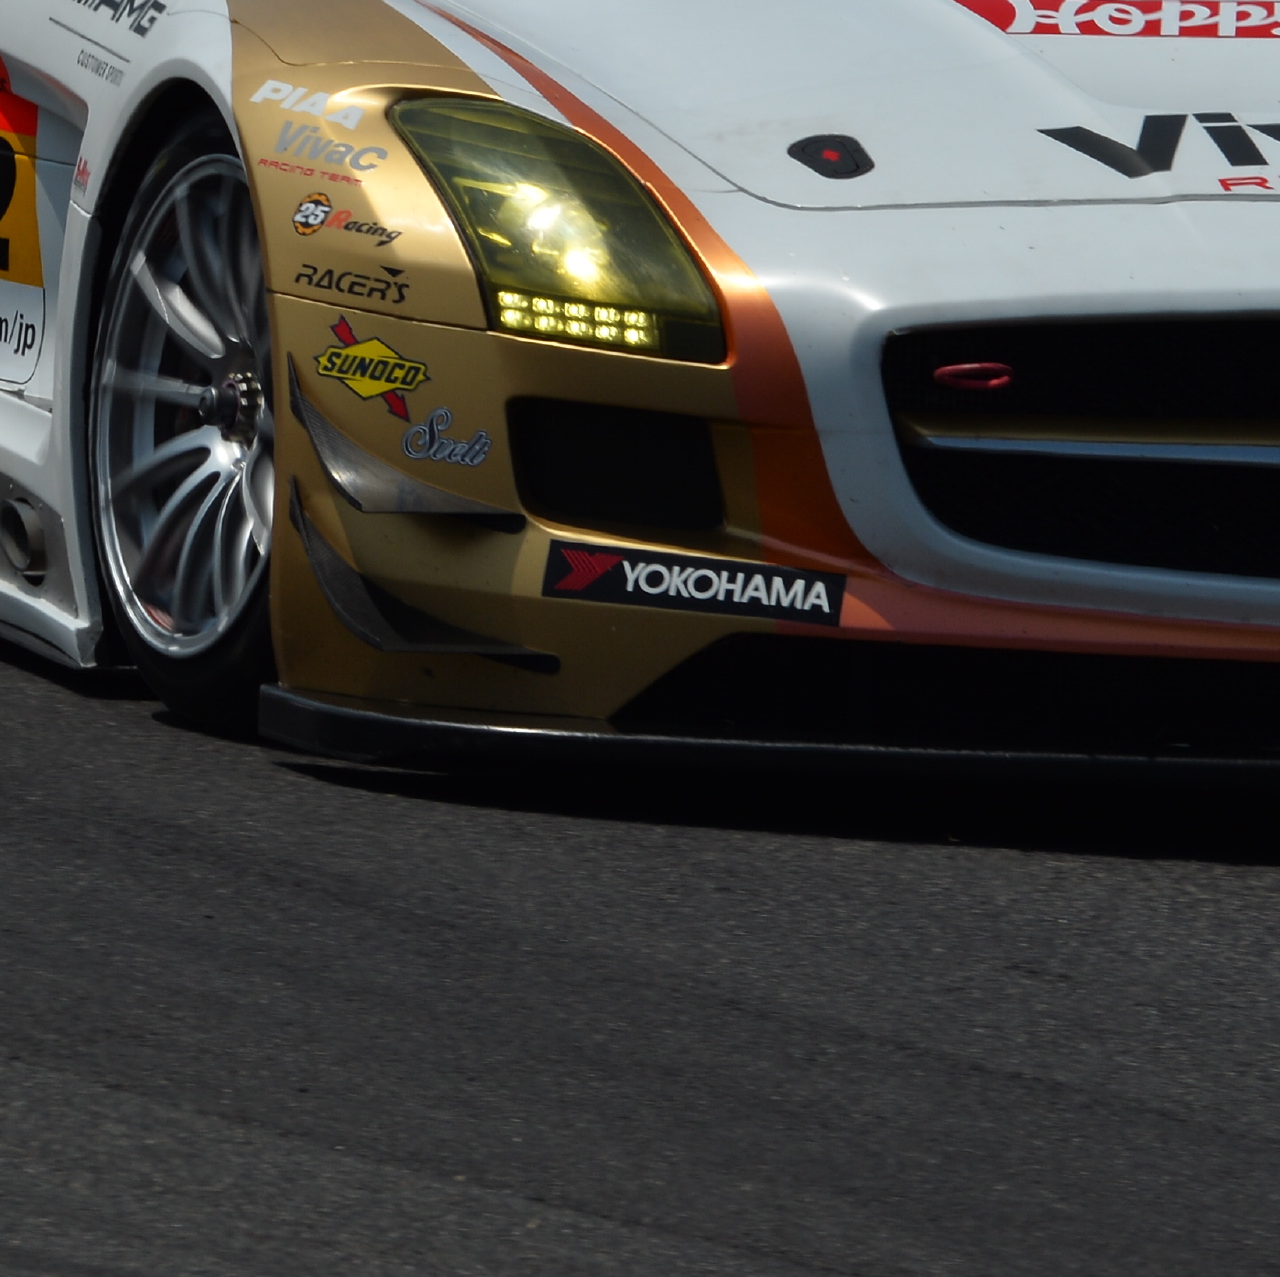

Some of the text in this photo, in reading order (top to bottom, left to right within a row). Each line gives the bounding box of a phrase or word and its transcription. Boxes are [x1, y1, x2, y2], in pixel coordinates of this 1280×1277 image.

[249, 79, 366, 131] PIAA
[274, 119, 388, 172] VivaC
[257, 158, 363, 187] RACING TEAM
[293, 202, 404, 247] 25 Racing
[322, 351, 422, 386] SUNOCO
[621, 559, 832, 614] YOKOHAMA
